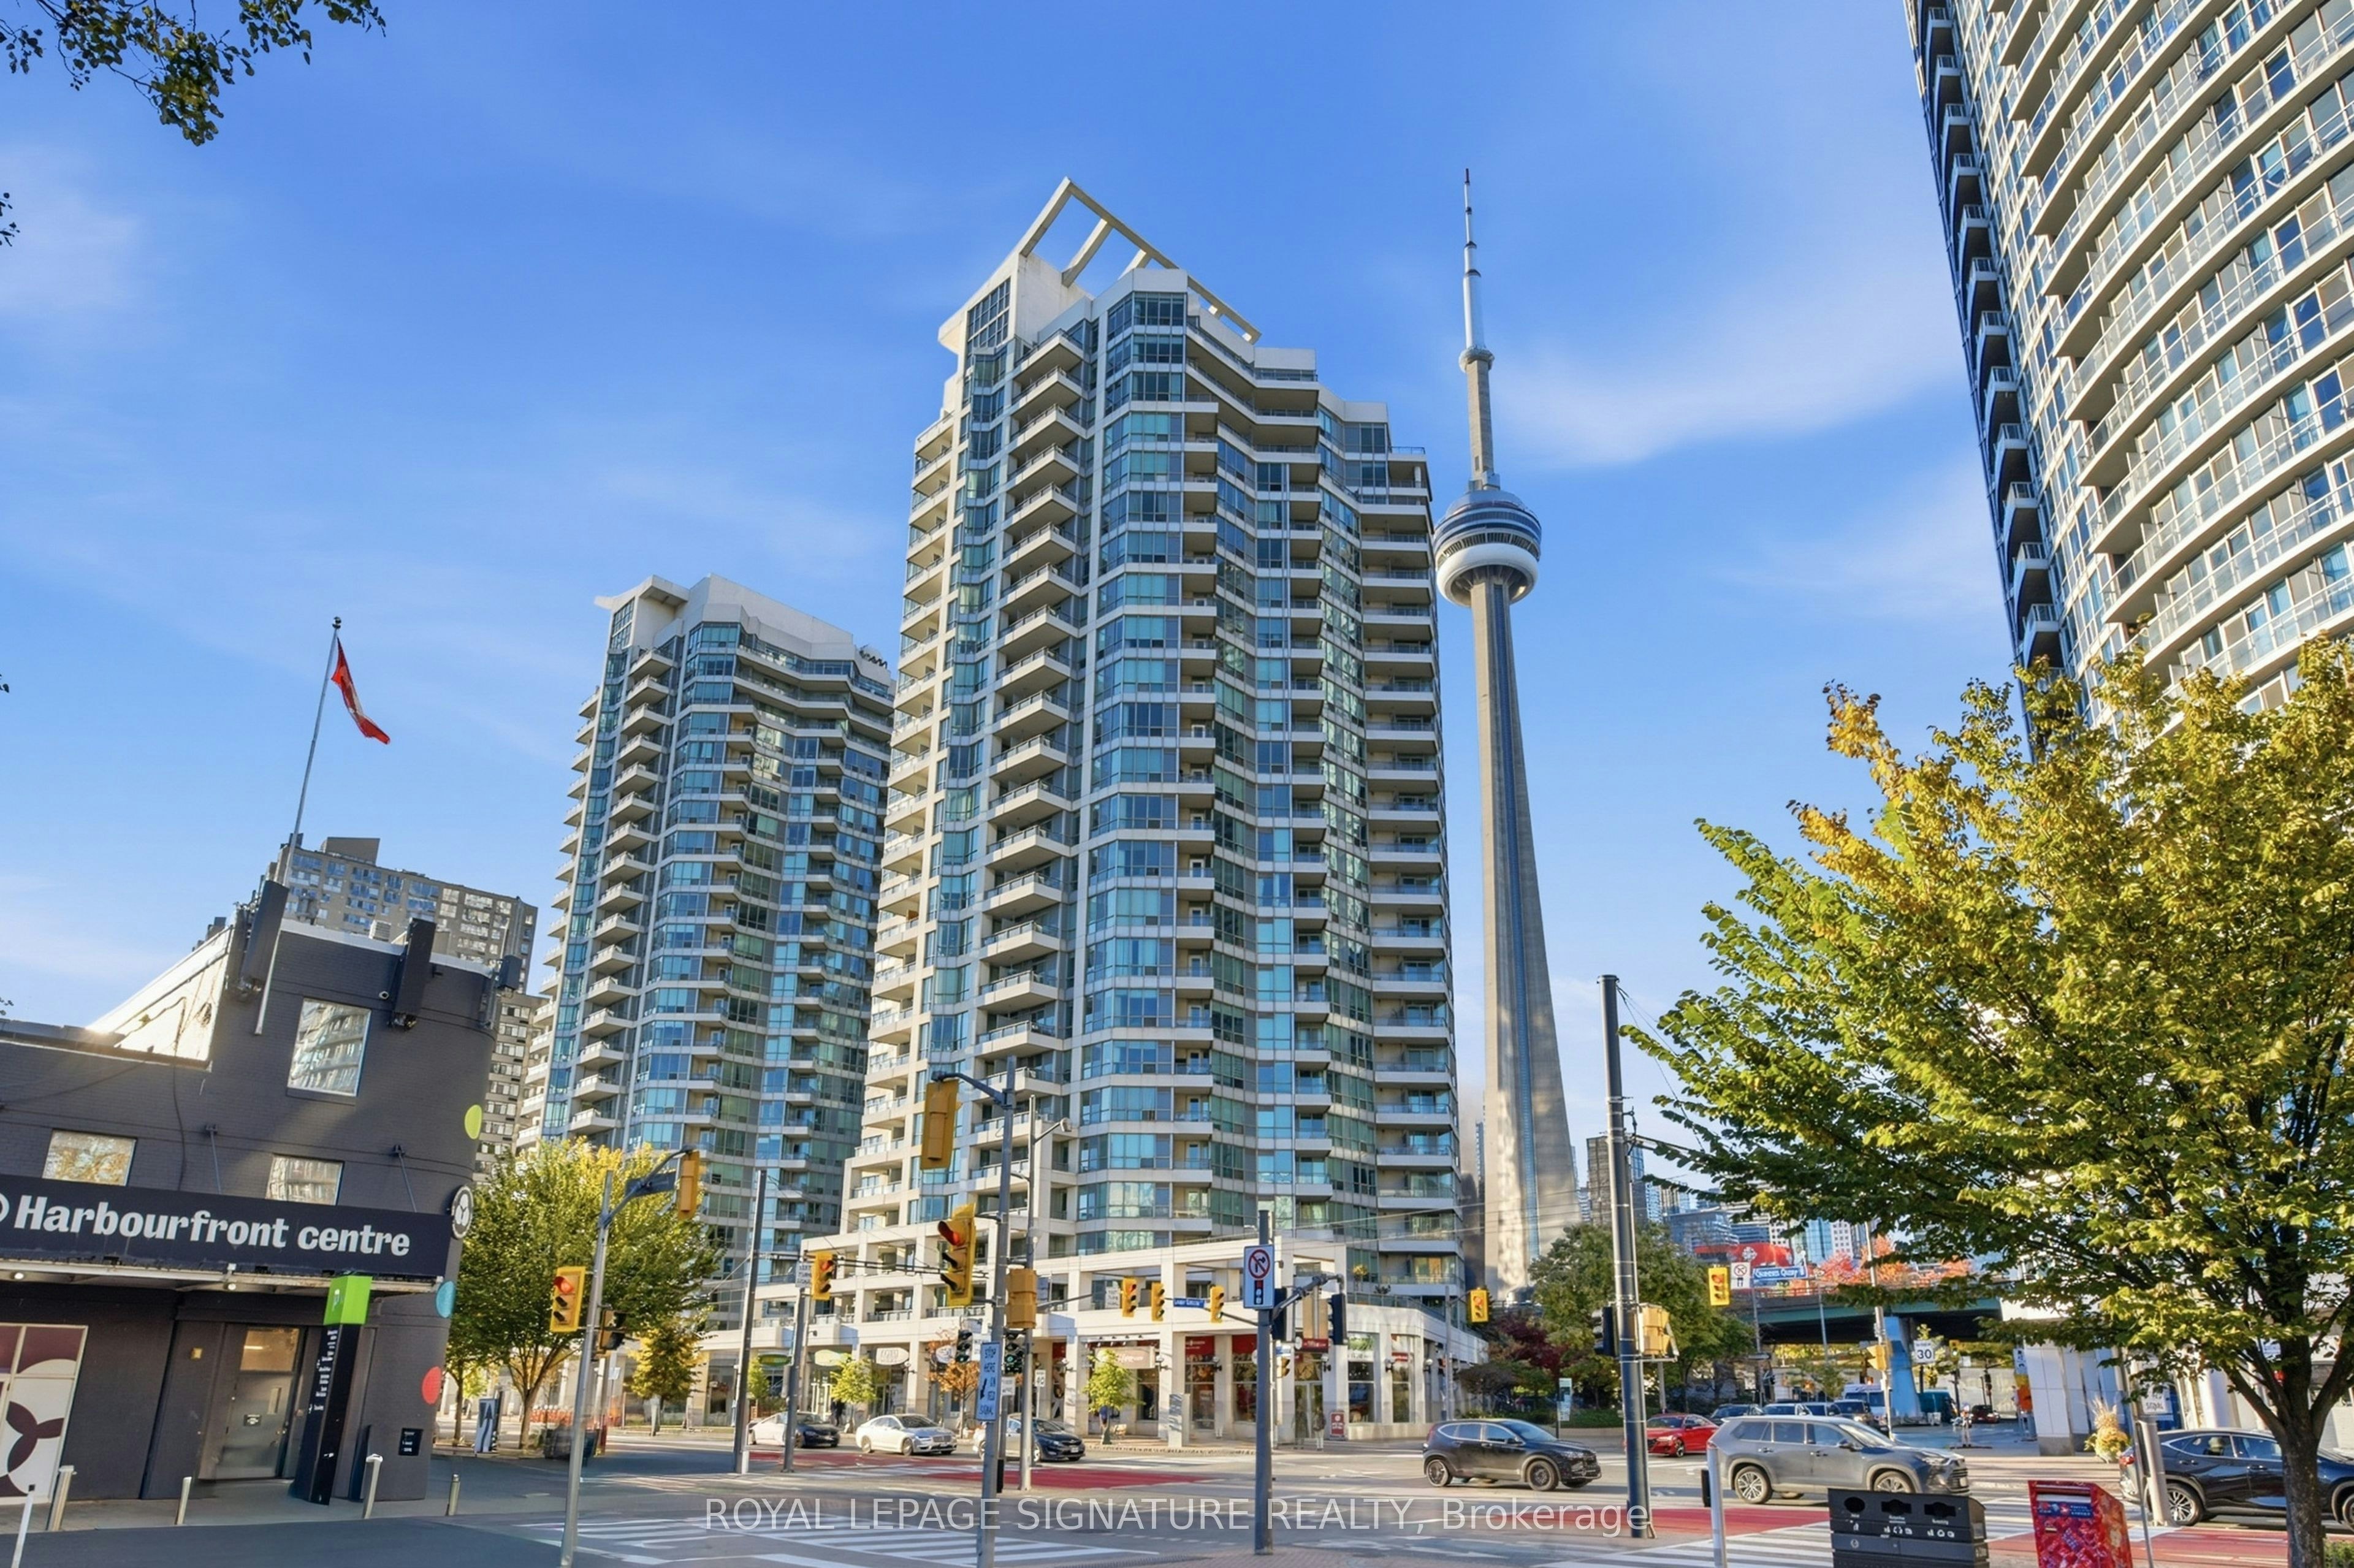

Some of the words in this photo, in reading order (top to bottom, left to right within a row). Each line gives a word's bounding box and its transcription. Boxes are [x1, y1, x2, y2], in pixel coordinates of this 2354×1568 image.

[14, 1195, 289, 1248] Harbourfront
[297, 1225, 410, 1256] centre
[1917, 1349, 1932, 1360] 30
